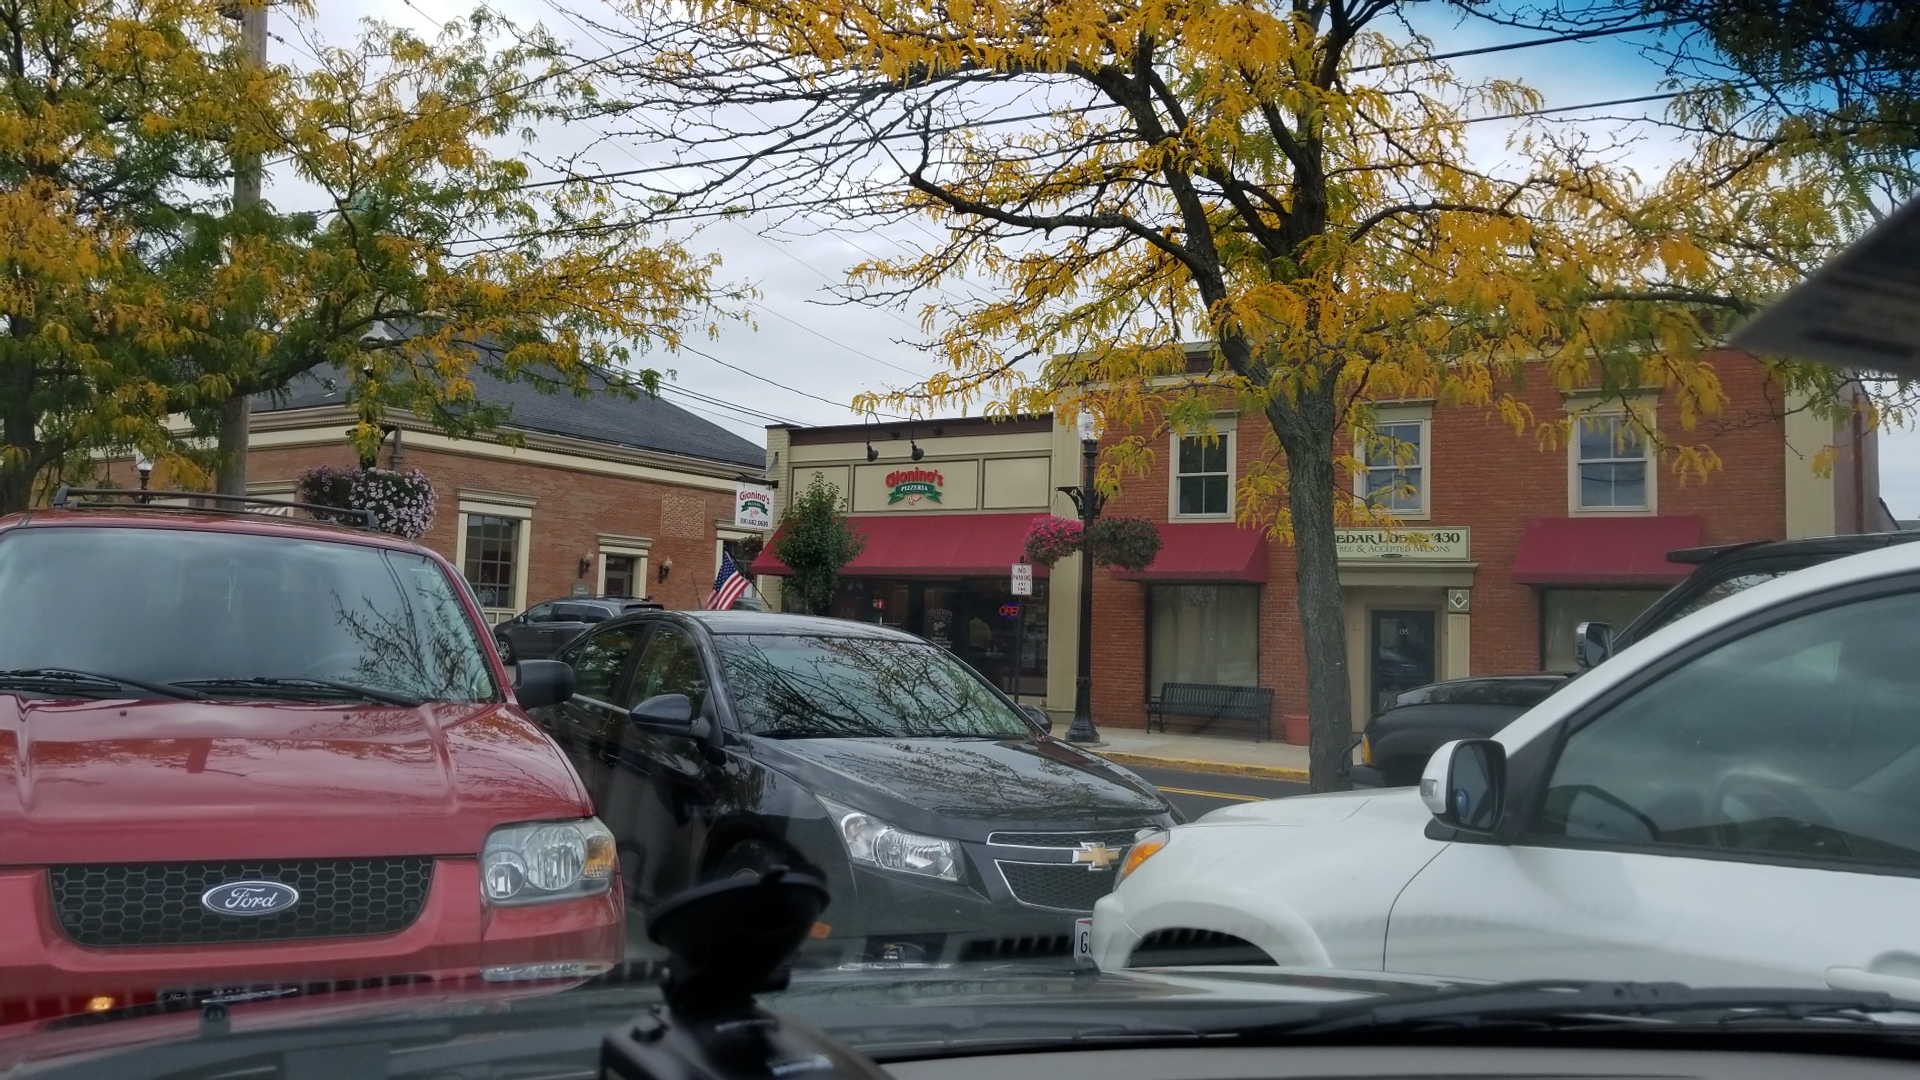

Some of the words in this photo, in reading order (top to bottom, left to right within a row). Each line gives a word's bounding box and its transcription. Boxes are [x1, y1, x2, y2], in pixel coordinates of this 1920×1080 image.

[885, 466, 944, 488] Gionino's
[900, 484, 929, 492] PIZZERIA
[739, 489, 770, 505] Gionino's
[1335, 534, 1378, 545] EDAR
[1356, 544, 1366, 554] &
[1368, 545, 1410, 553] ACCEPTED
[999, 606, 1019, 616] OPE
[225, 887, 278, 908] Ford
